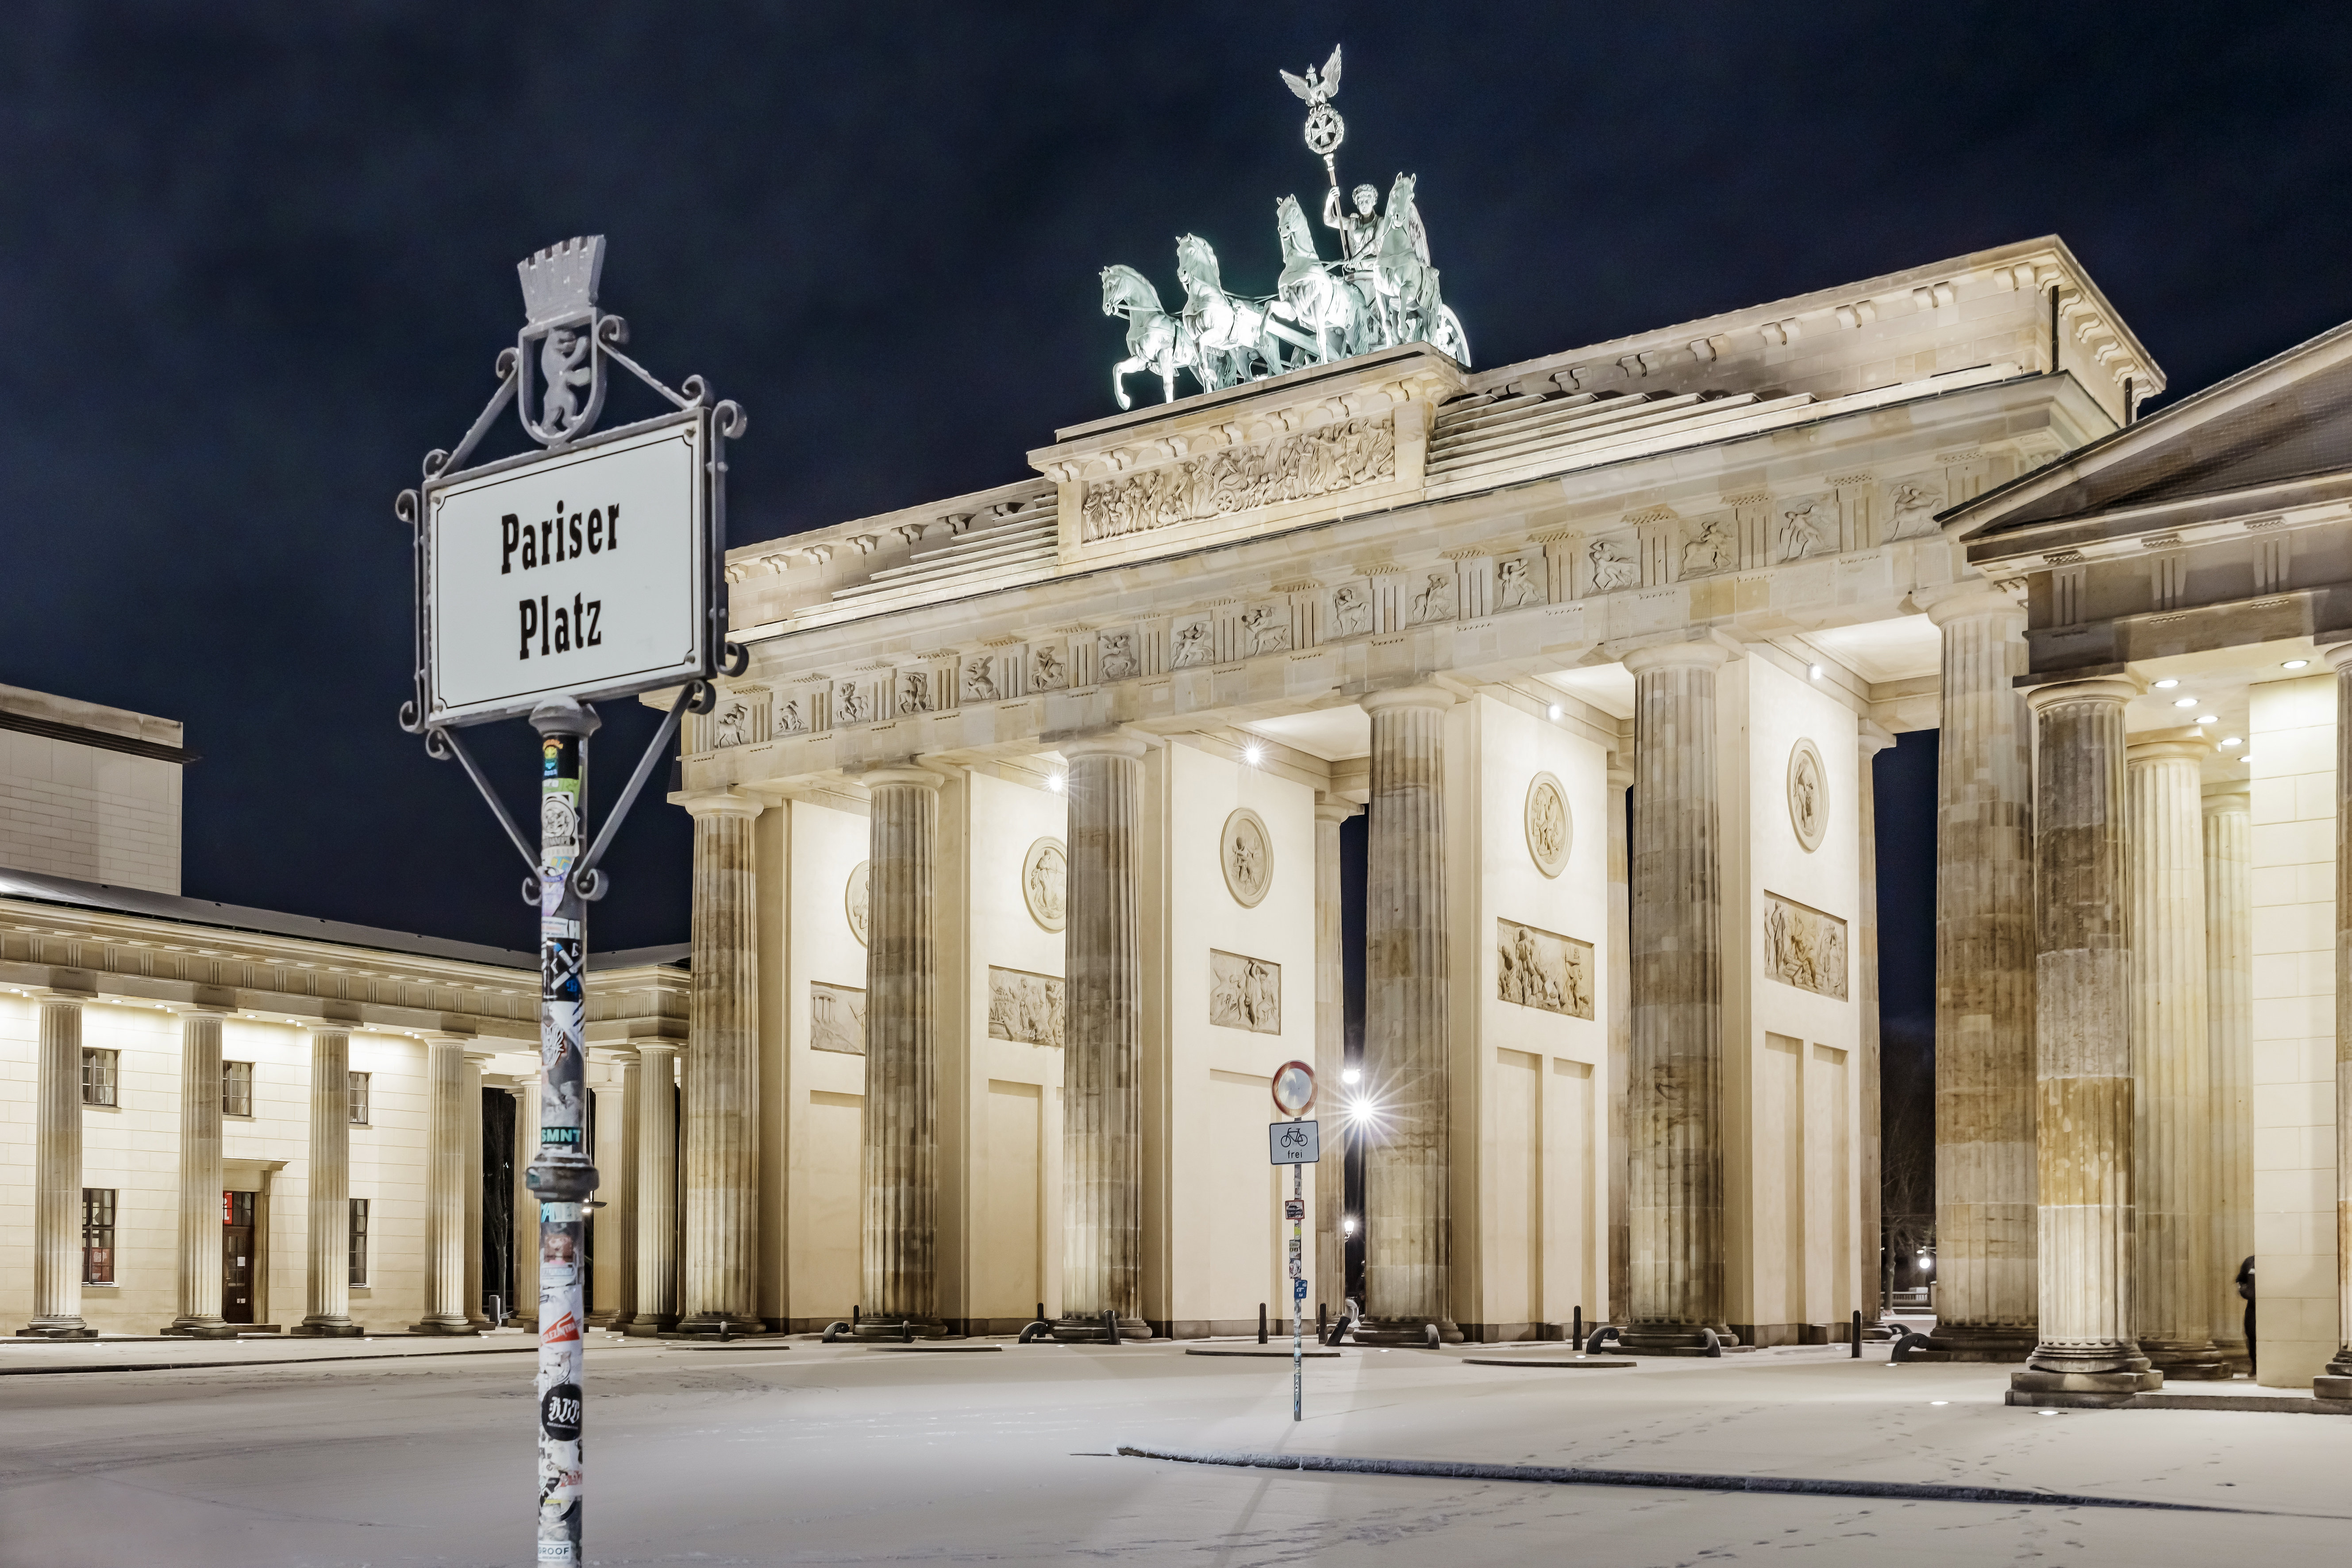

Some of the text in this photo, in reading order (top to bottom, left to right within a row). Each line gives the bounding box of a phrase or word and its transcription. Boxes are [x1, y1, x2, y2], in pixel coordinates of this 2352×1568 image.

[501, 500, 619, 575] Pariser
[519, 592, 601, 660] Platz
[1288, 1150, 1302, 1159] frei
